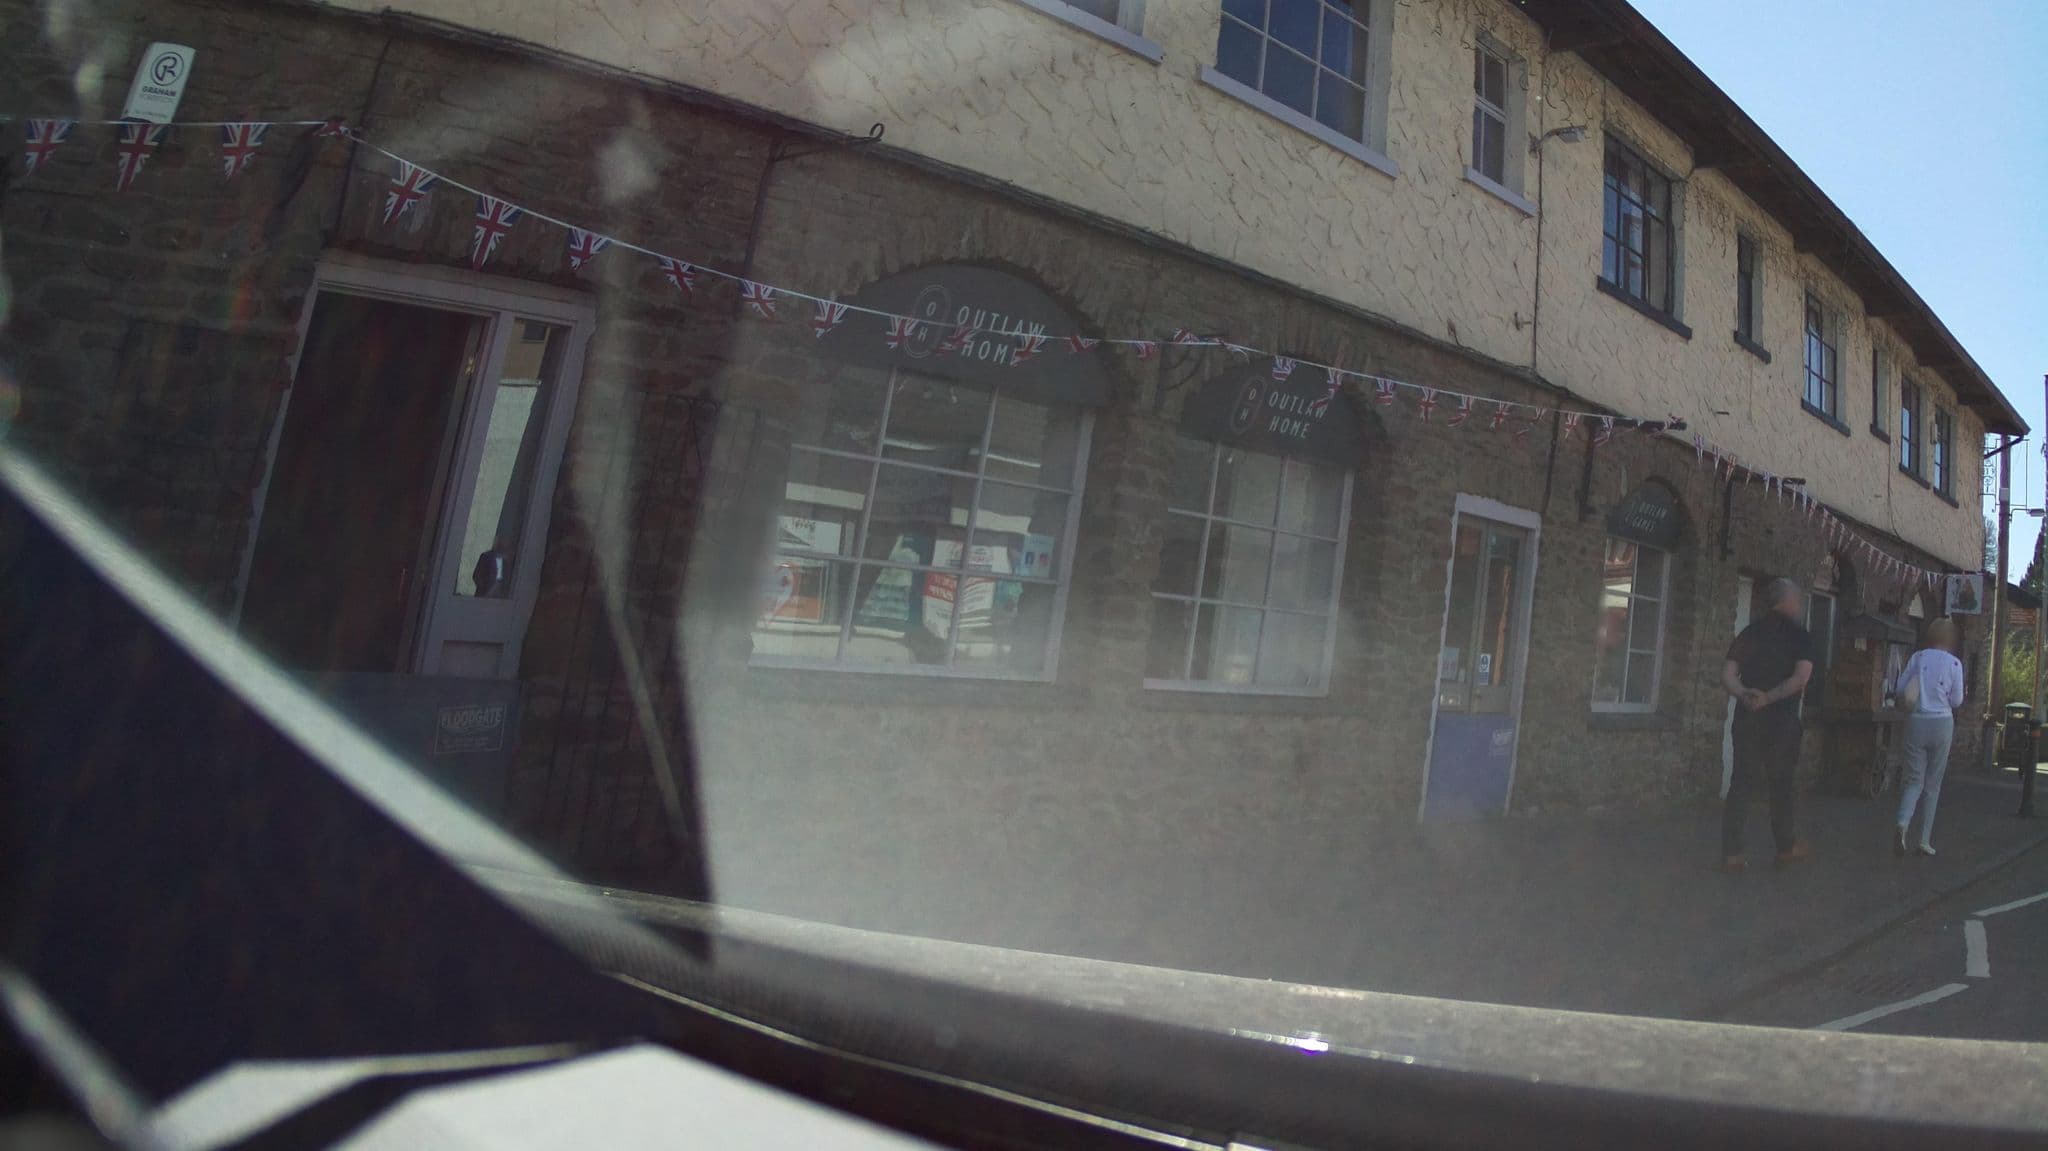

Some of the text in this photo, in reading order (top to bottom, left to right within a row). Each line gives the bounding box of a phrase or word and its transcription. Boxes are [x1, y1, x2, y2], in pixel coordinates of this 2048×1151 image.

[957, 305, 1045, 337] OUTLAW
[1269, 391, 1328, 419] OUTLAW
[1269, 415, 1310, 439] HOME
[440, 706, 503, 729] FLOODGATE
